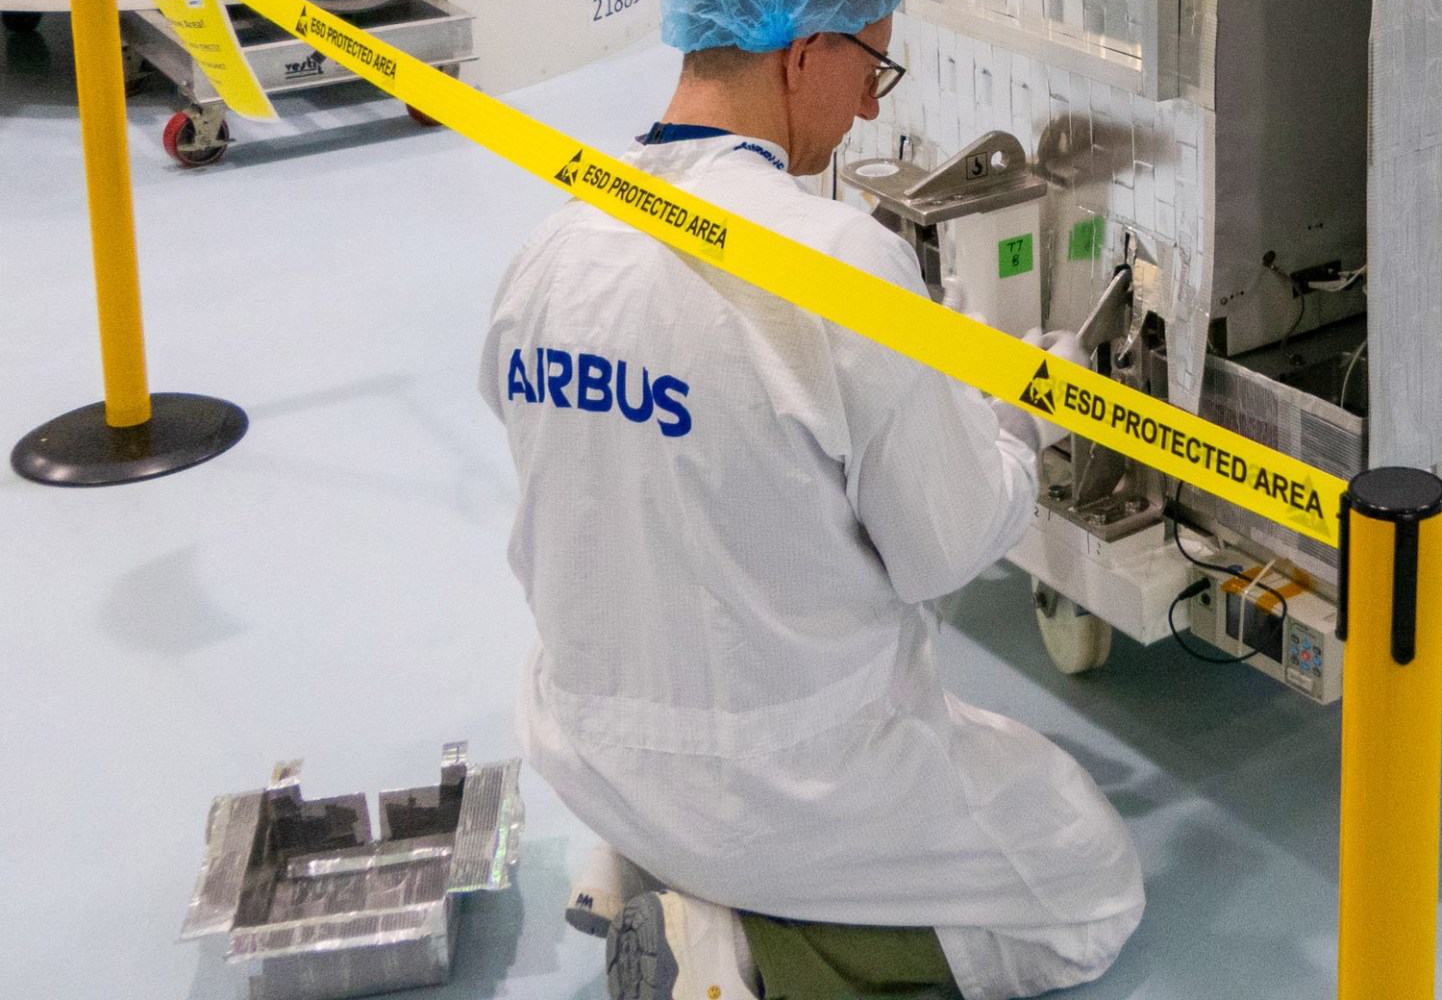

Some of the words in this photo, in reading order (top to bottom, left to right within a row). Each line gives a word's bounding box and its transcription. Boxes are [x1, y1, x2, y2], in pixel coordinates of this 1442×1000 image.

[310, 17, 326, 38] ESD
[326, 27, 373, 65] PROTECTED
[373, 53, 397, 79] AREA
[582, 164, 609, 189] ESD
[608, 177, 688, 228] PROTECTED
[685, 215, 728, 249] AREA
[508, 347, 692, 437] AIRBUS
[1064, 383, 1106, 422] ESD
[1111, 404, 1247, 484] PROTECTED
[1253, 468, 1324, 520] AREA
